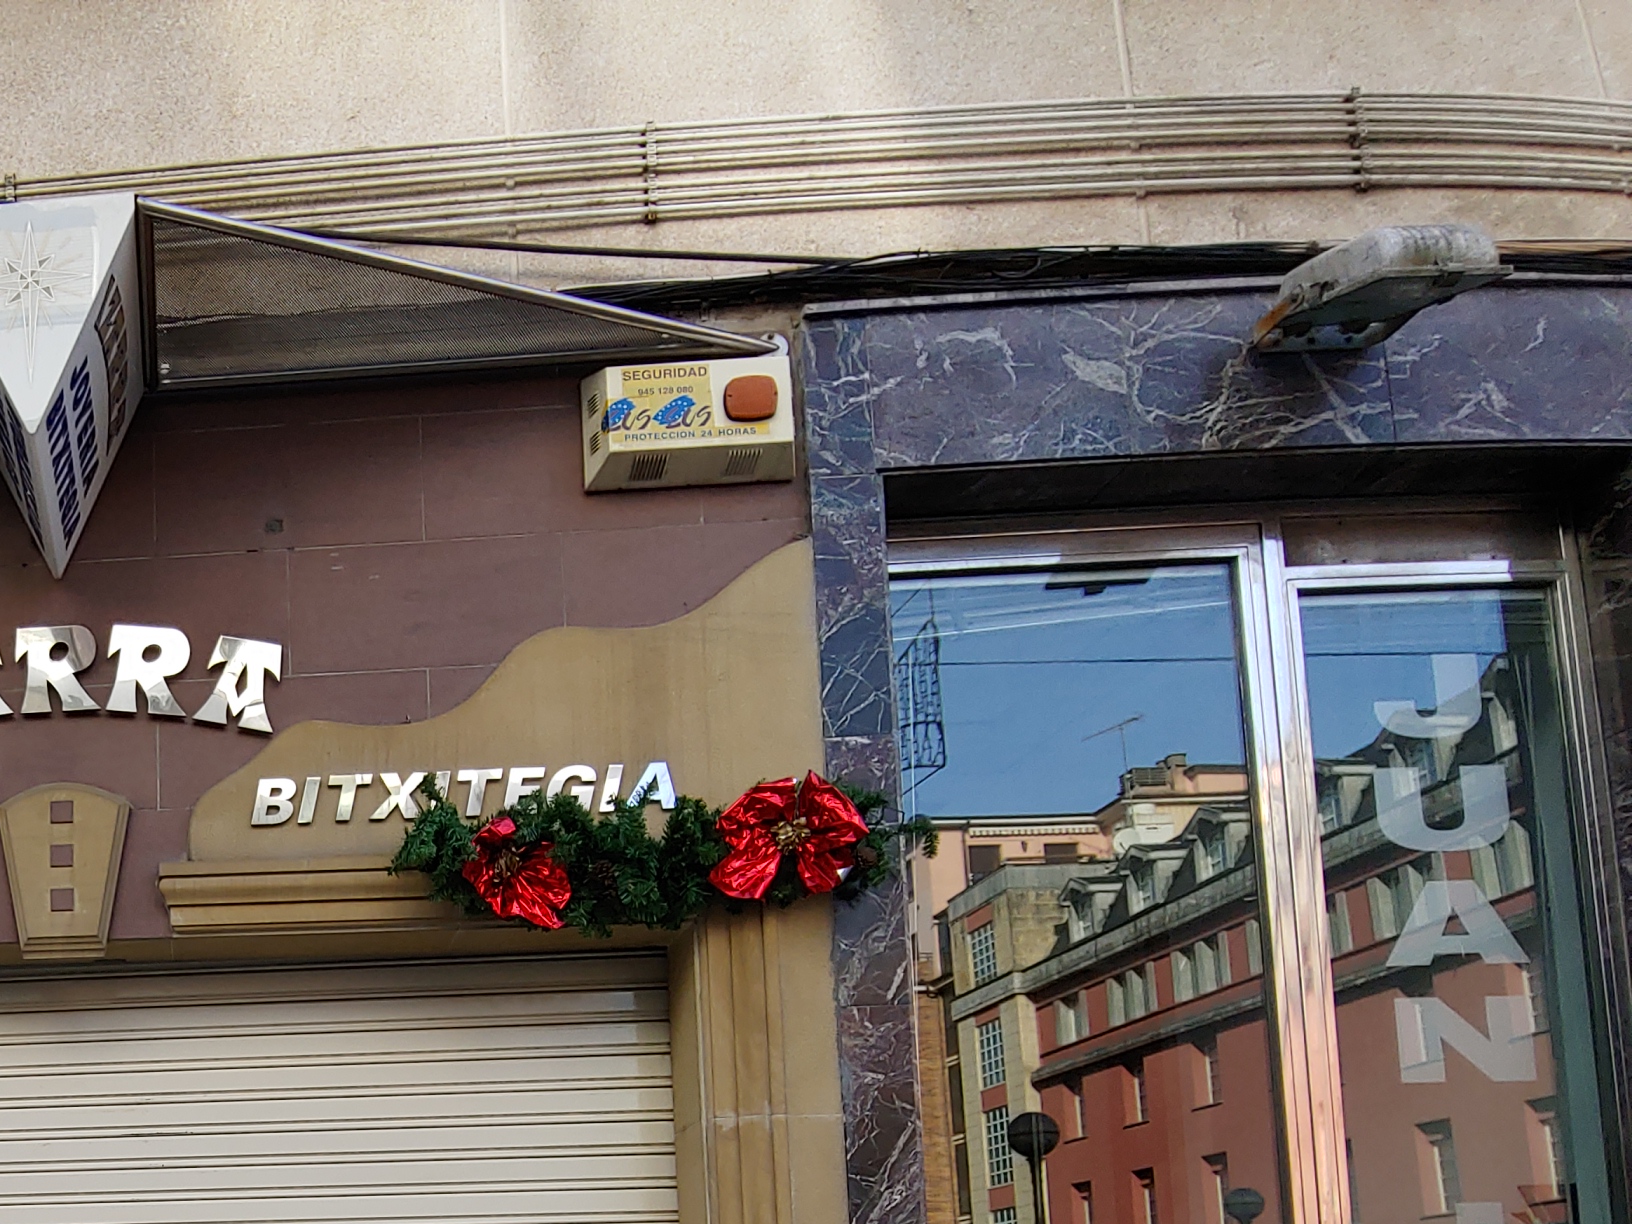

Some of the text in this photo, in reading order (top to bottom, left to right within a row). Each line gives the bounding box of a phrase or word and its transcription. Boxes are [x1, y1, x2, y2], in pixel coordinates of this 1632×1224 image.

[622, 366, 707, 381] SEGURIDAD
[638, 387, 655, 395] 945
[658, 386, 674, 394] 128
[70, 355, 100, 499] JOYERIA
[624, 427, 757, 442] PROTECCION 24 HORAS
[1374, 654, 1537, 1083] JUAN
